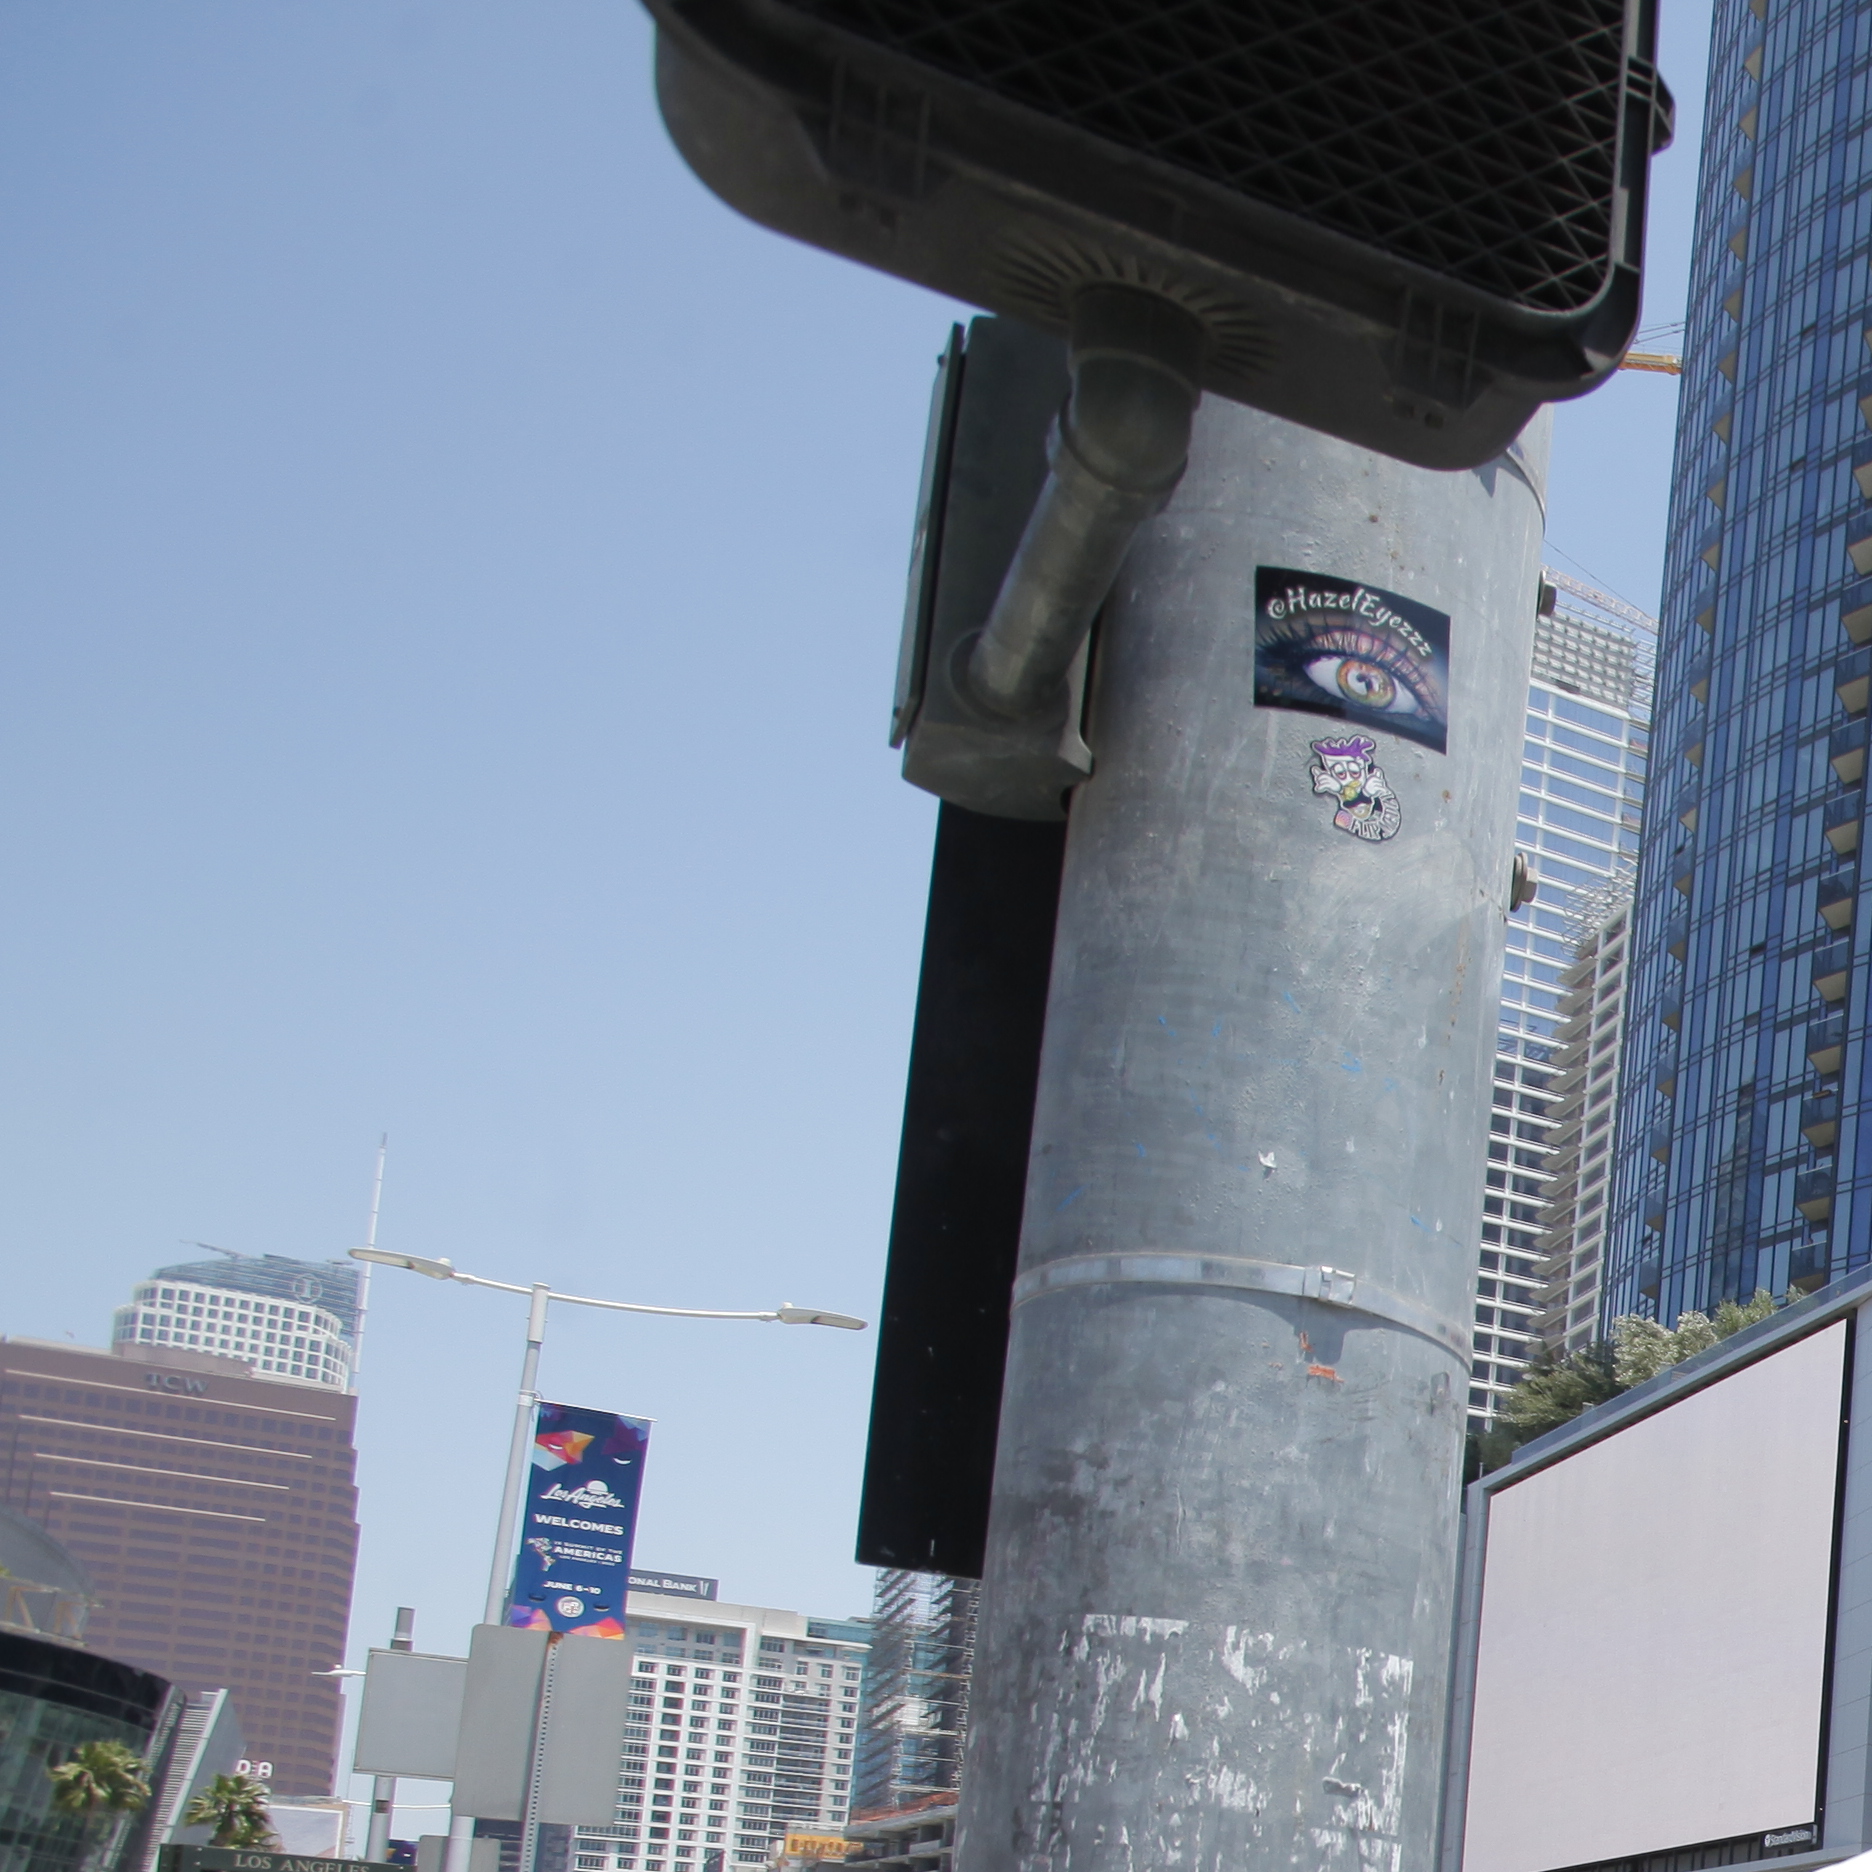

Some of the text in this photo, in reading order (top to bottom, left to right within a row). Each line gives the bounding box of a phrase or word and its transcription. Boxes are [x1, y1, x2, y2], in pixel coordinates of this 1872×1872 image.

[1267, 586, 1432, 657] @HazelEyezzz
[535, 1514, 624, 1535] WELCOMES
[554, 1546, 622, 1563] AMERICAS
[543, 1581, 573, 1591] JUNE
[234, 1854, 272, 1869] LOS
